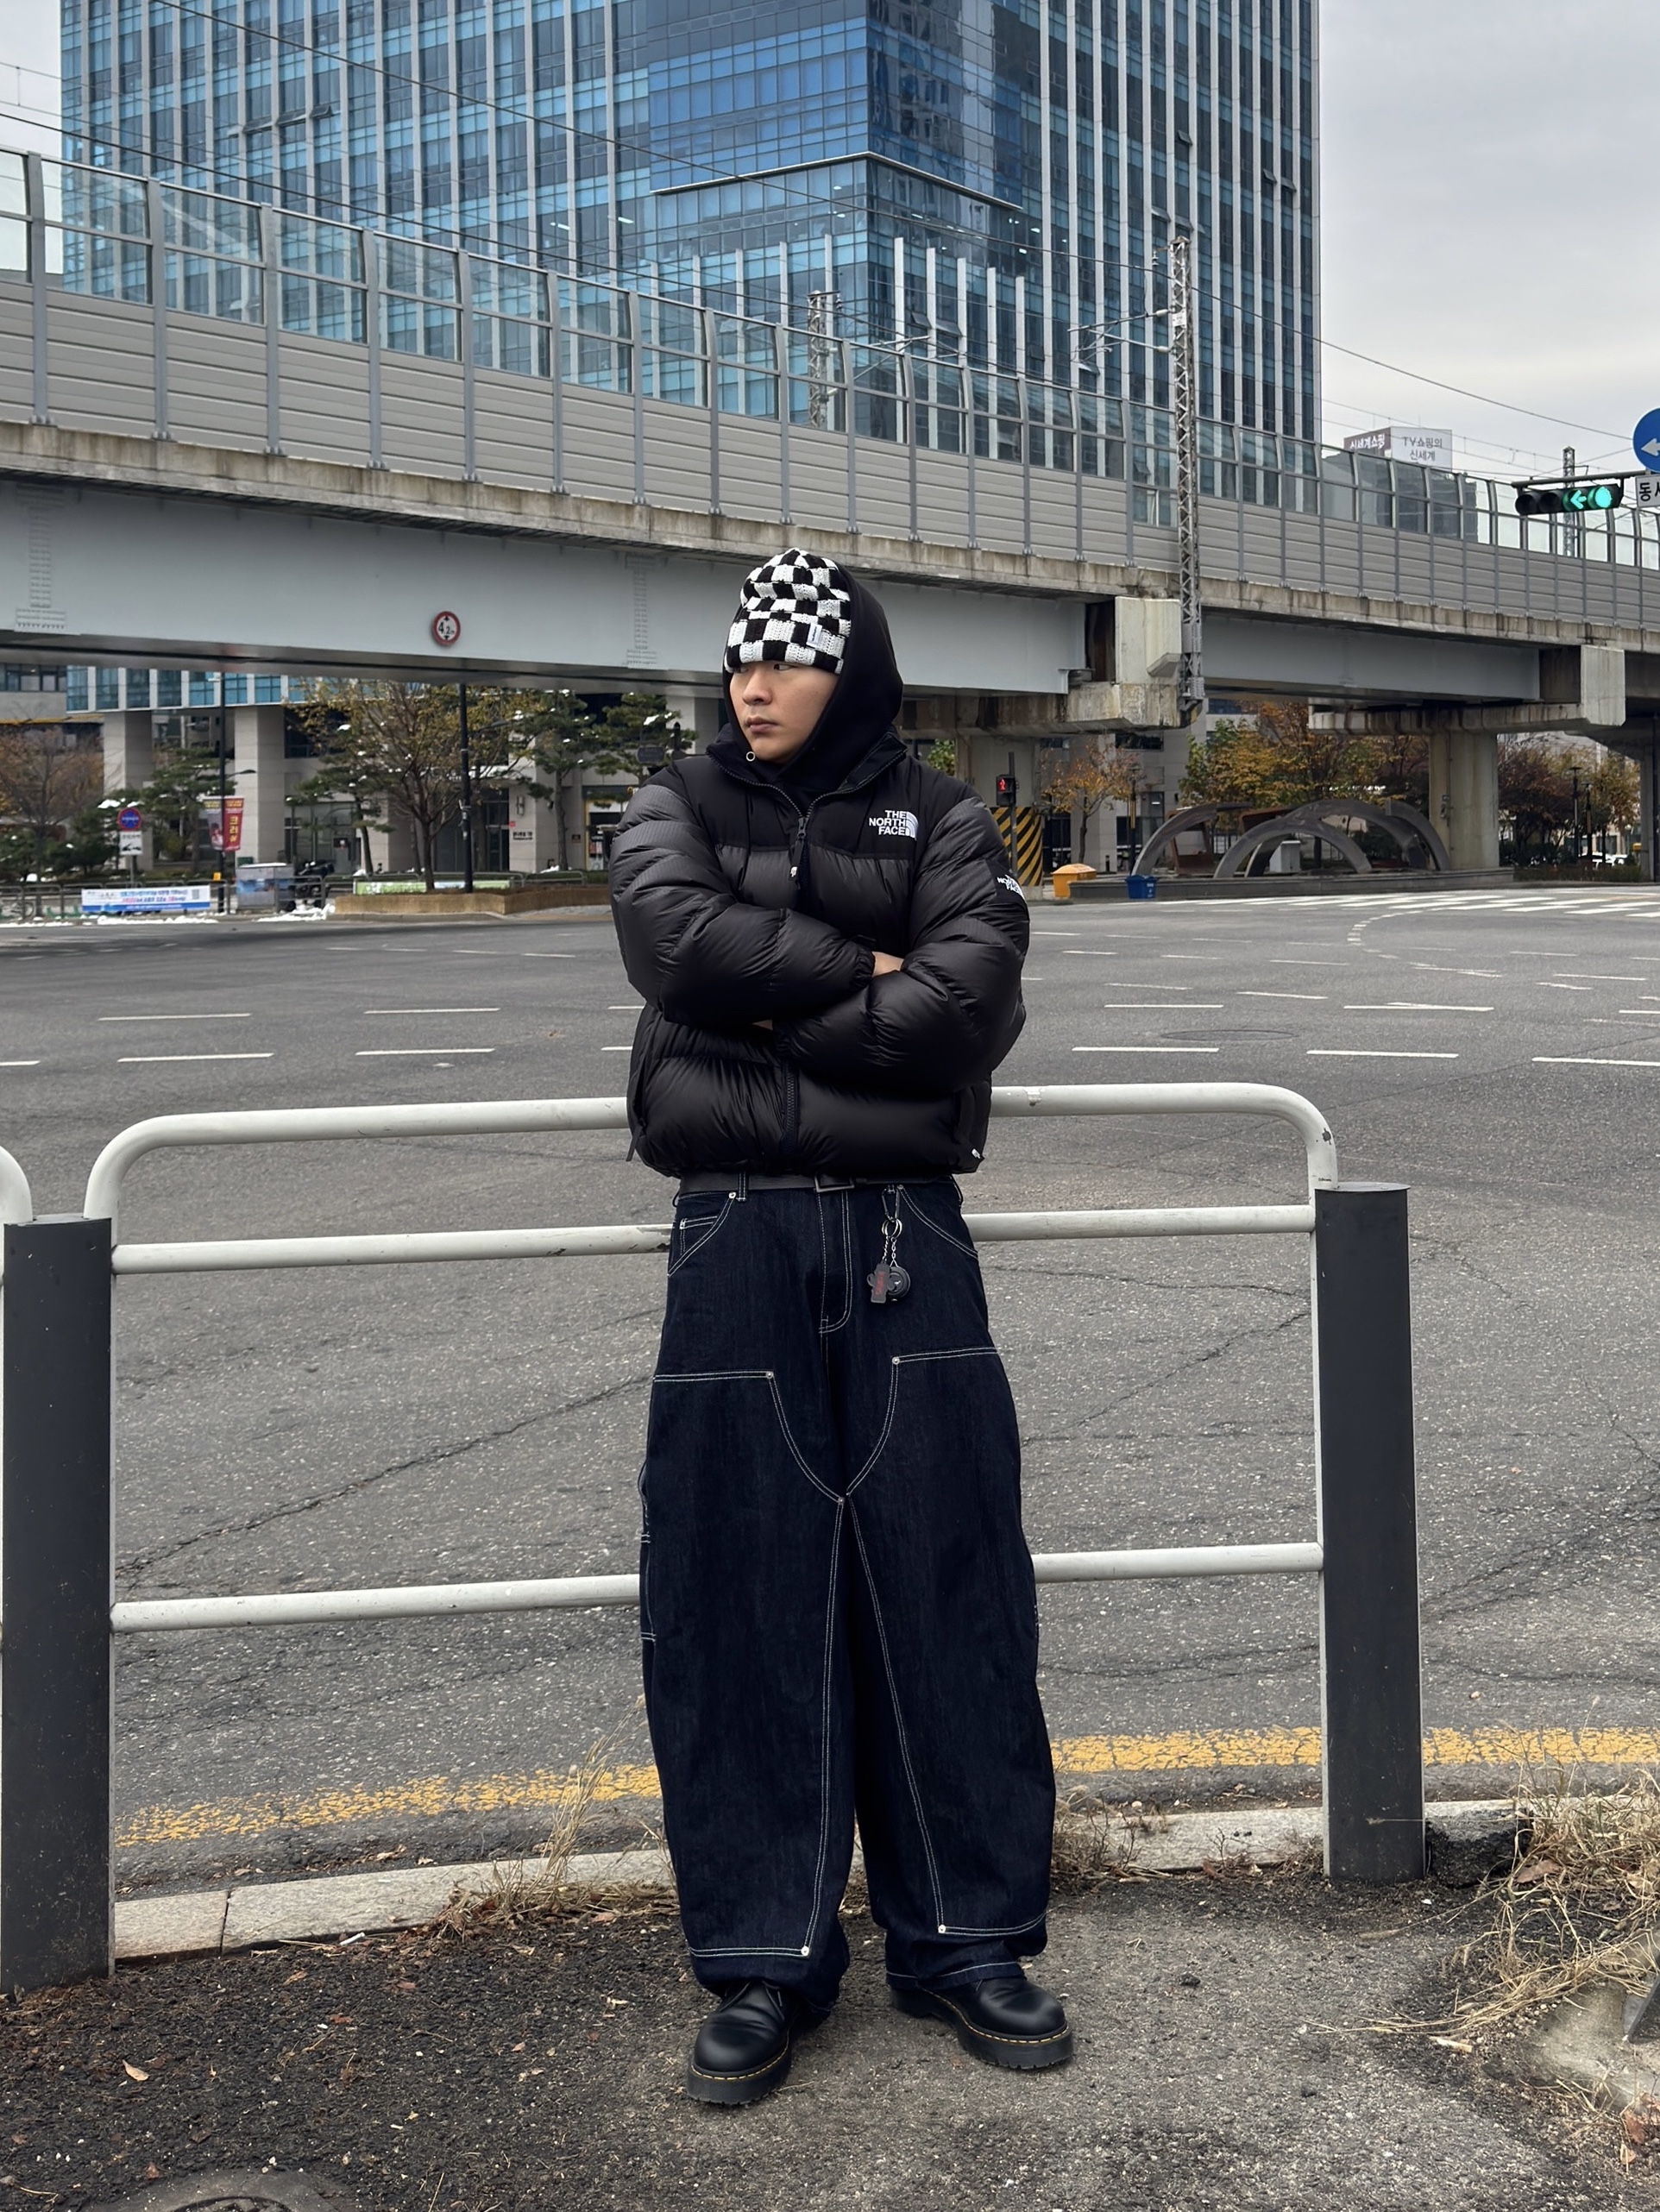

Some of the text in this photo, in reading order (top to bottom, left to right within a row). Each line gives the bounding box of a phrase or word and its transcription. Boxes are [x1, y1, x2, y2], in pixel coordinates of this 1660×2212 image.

[1350, 433, 1385, 449] 신세계쇼핑
[1403, 437, 1443, 449] TV쇼핑의
[1410, 449, 1436, 461] 신세계
[884, 810, 907, 819] THE
[869, 818, 906, 826] NORTH
[878, 826, 906, 836] FACE
